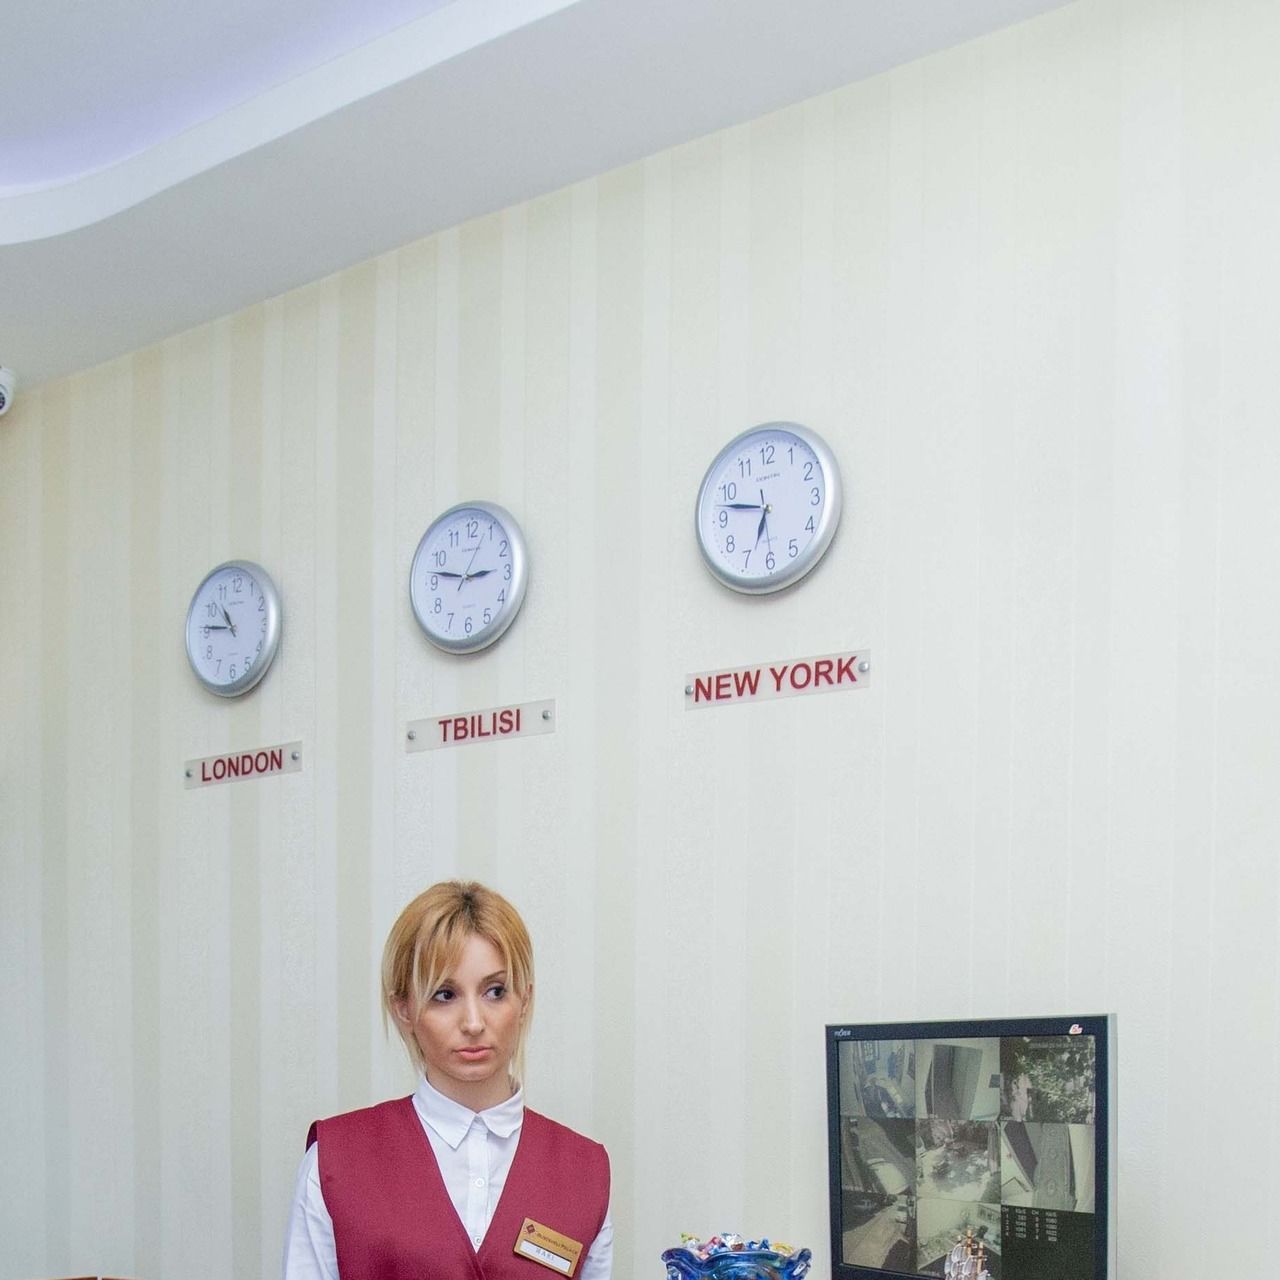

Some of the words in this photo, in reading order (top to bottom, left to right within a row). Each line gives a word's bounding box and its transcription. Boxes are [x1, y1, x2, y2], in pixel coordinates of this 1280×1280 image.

[760, 445, 775, 465] 12
[738, 459, 751, 479] 11
[804, 462, 813, 481] 2
[721, 482, 737, 501] 10
[811, 487, 820, 505] 3
[719, 511, 728, 528] 9
[805, 516, 815, 533] 4
[466, 521, 478, 538] 12
[449, 531, 459, 548] 11
[726, 535, 735, 553] 8
[499, 540, 508, 557] 2
[789, 539, 798, 558] 5
[433, 550, 447, 567] 10
[742, 550, 751, 568] 7
[765, 551, 775, 569] 6
[504, 564, 511, 580] 3
[232, 577, 242, 593] 12
[430, 575, 438, 591] 9
[219, 585, 227, 600] 11
[497, 589, 505, 604] 4
[206, 602, 217, 617] 10
[258, 596, 265, 611] 2
[434, 598, 442, 614] 8
[448, 613, 454, 630] 7
[465, 617, 472, 633] 6
[484, 608, 492, 625] 5
[206, 645, 213, 660] 8
[216, 659, 222, 677] 7
[230, 664, 236, 679] 6
[244, 657, 251, 672] 5
[695, 670, 761, 702] NEW
[770, 656, 857, 692] YORK
[438, 709, 521, 743] TBILISI
[202, 749, 283, 782] LONDON
